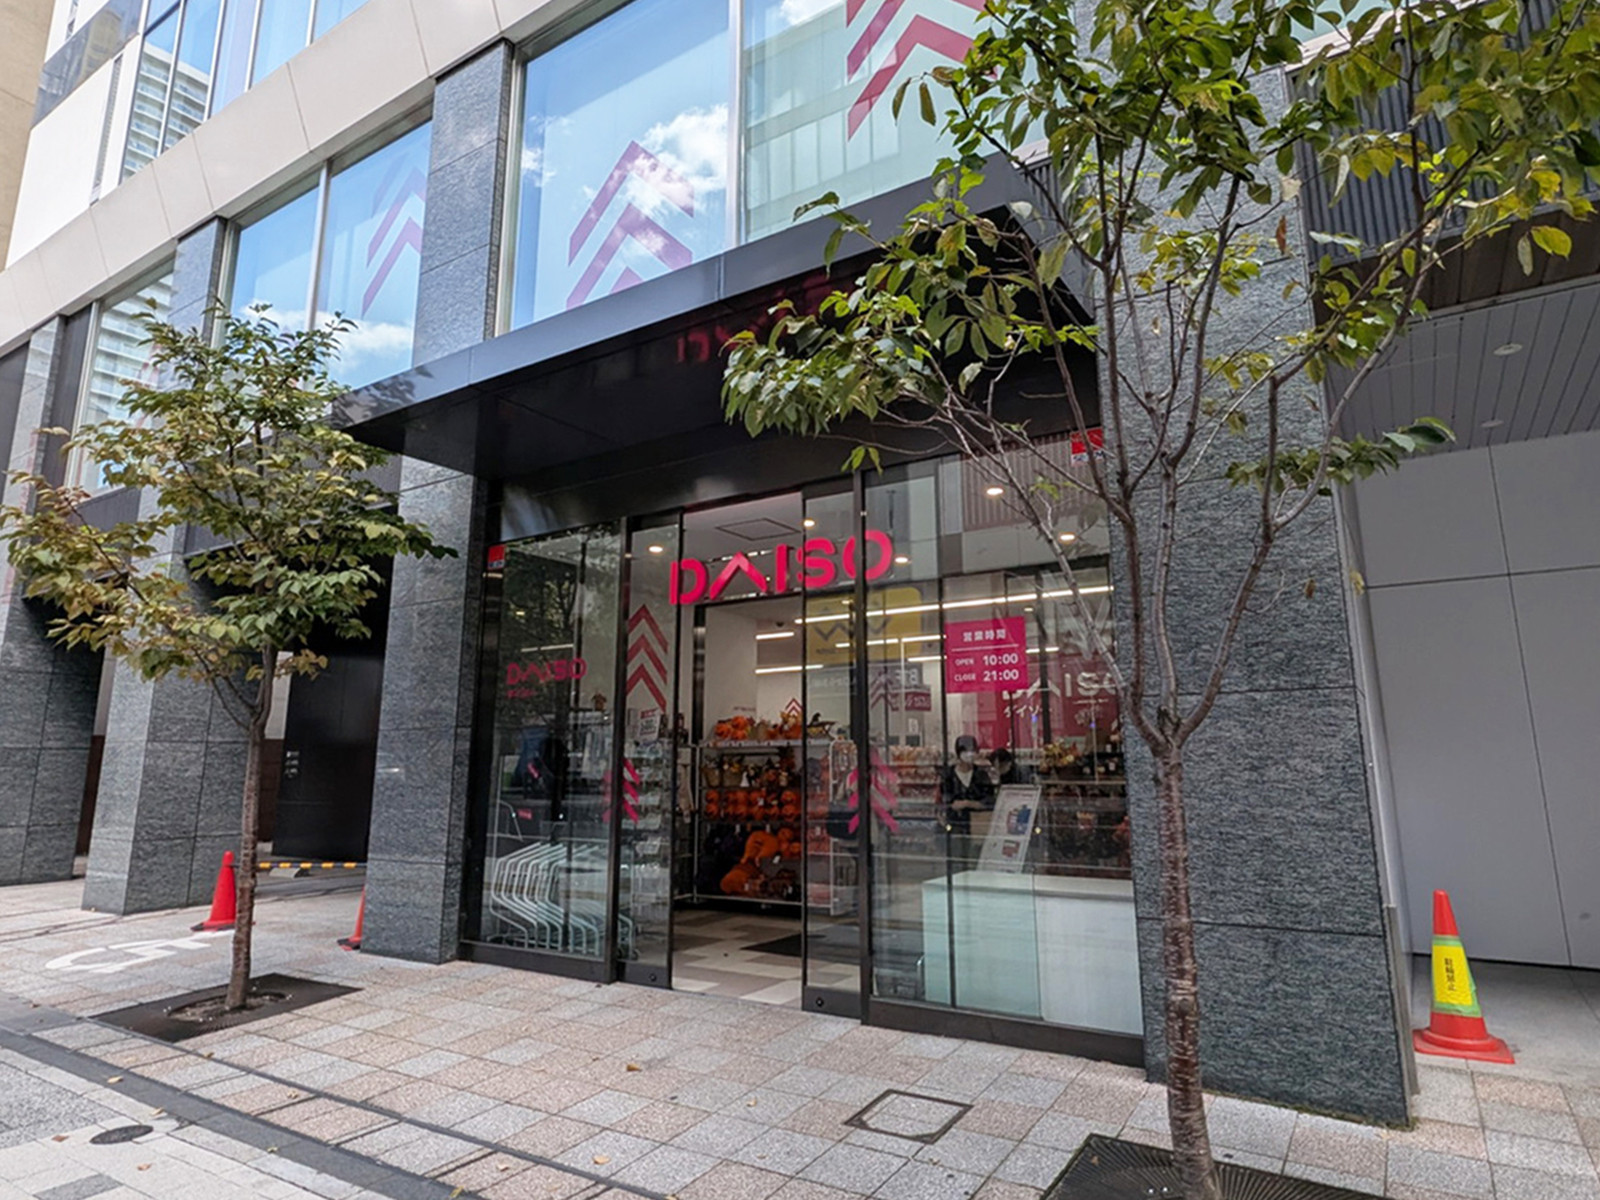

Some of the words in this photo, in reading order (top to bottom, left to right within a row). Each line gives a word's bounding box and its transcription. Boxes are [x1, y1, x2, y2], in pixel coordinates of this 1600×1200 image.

[670, 529, 893, 605] DAISO
[963, 628, 1006, 642] 営業時間
[955, 658, 975, 666] OPEN
[982, 653, 1019, 666] 10:00
[507, 657, 587, 686] DAISO
[953, 673, 976, 682] CLOSE
[983, 669, 1019, 682] 21:00
[1002, 672, 1118, 700] AIS
